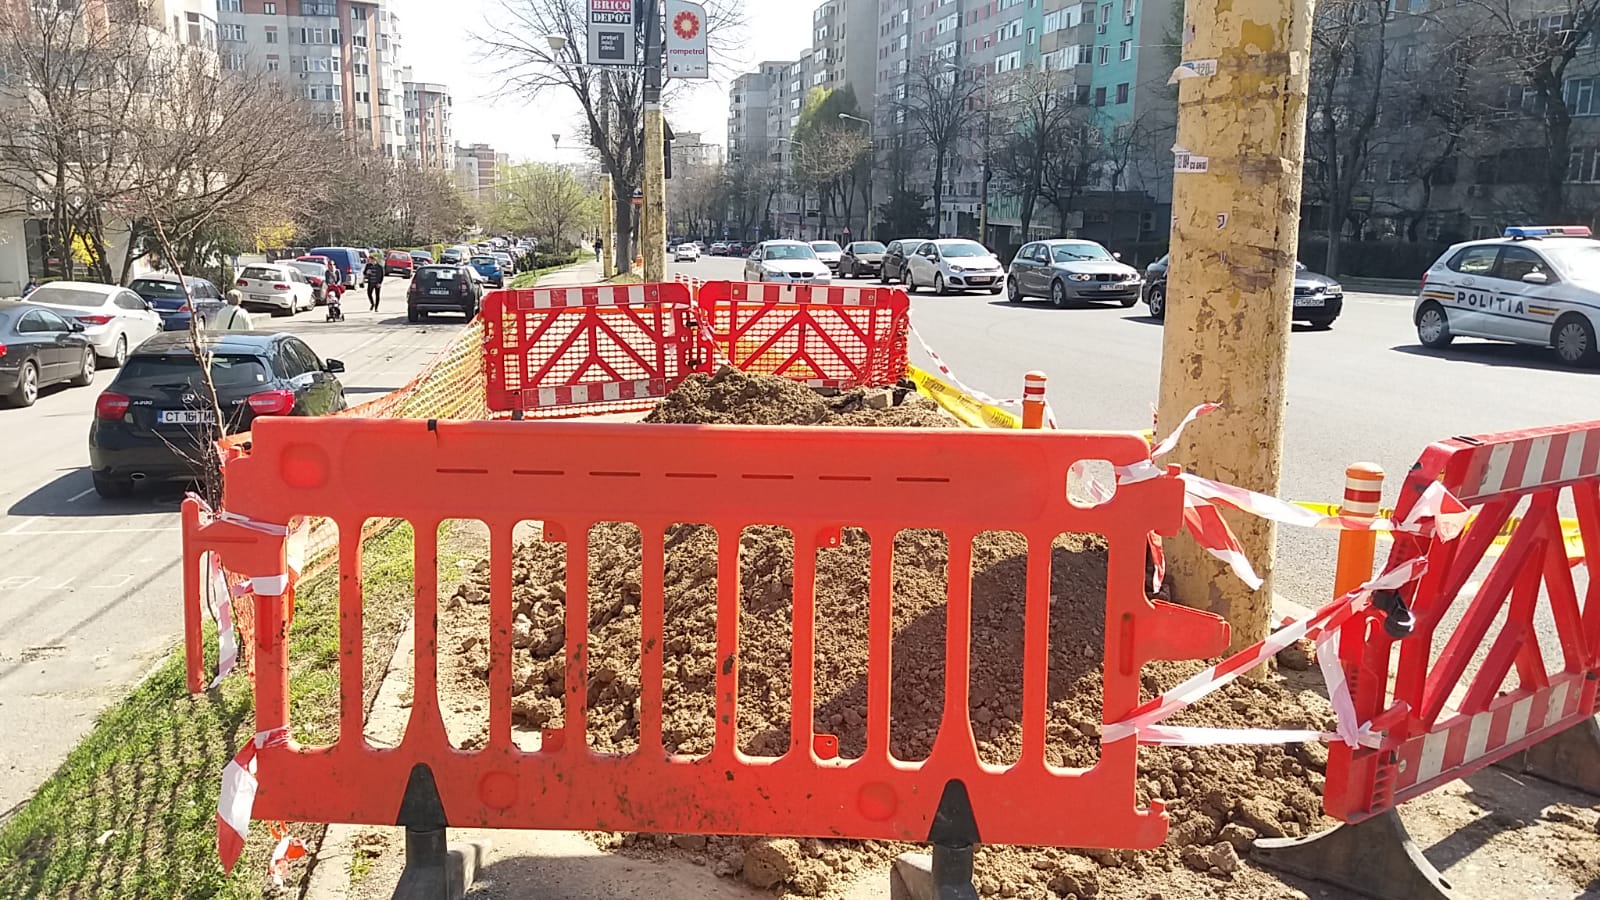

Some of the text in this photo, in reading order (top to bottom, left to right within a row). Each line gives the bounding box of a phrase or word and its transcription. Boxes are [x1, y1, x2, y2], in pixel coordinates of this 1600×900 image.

[593, 0, 630, 10] BRICO
[670, 48, 704, 56] rompetrol
[1457, 292, 1524, 314] POLITIA
[166, 412, 180, 422] CT
